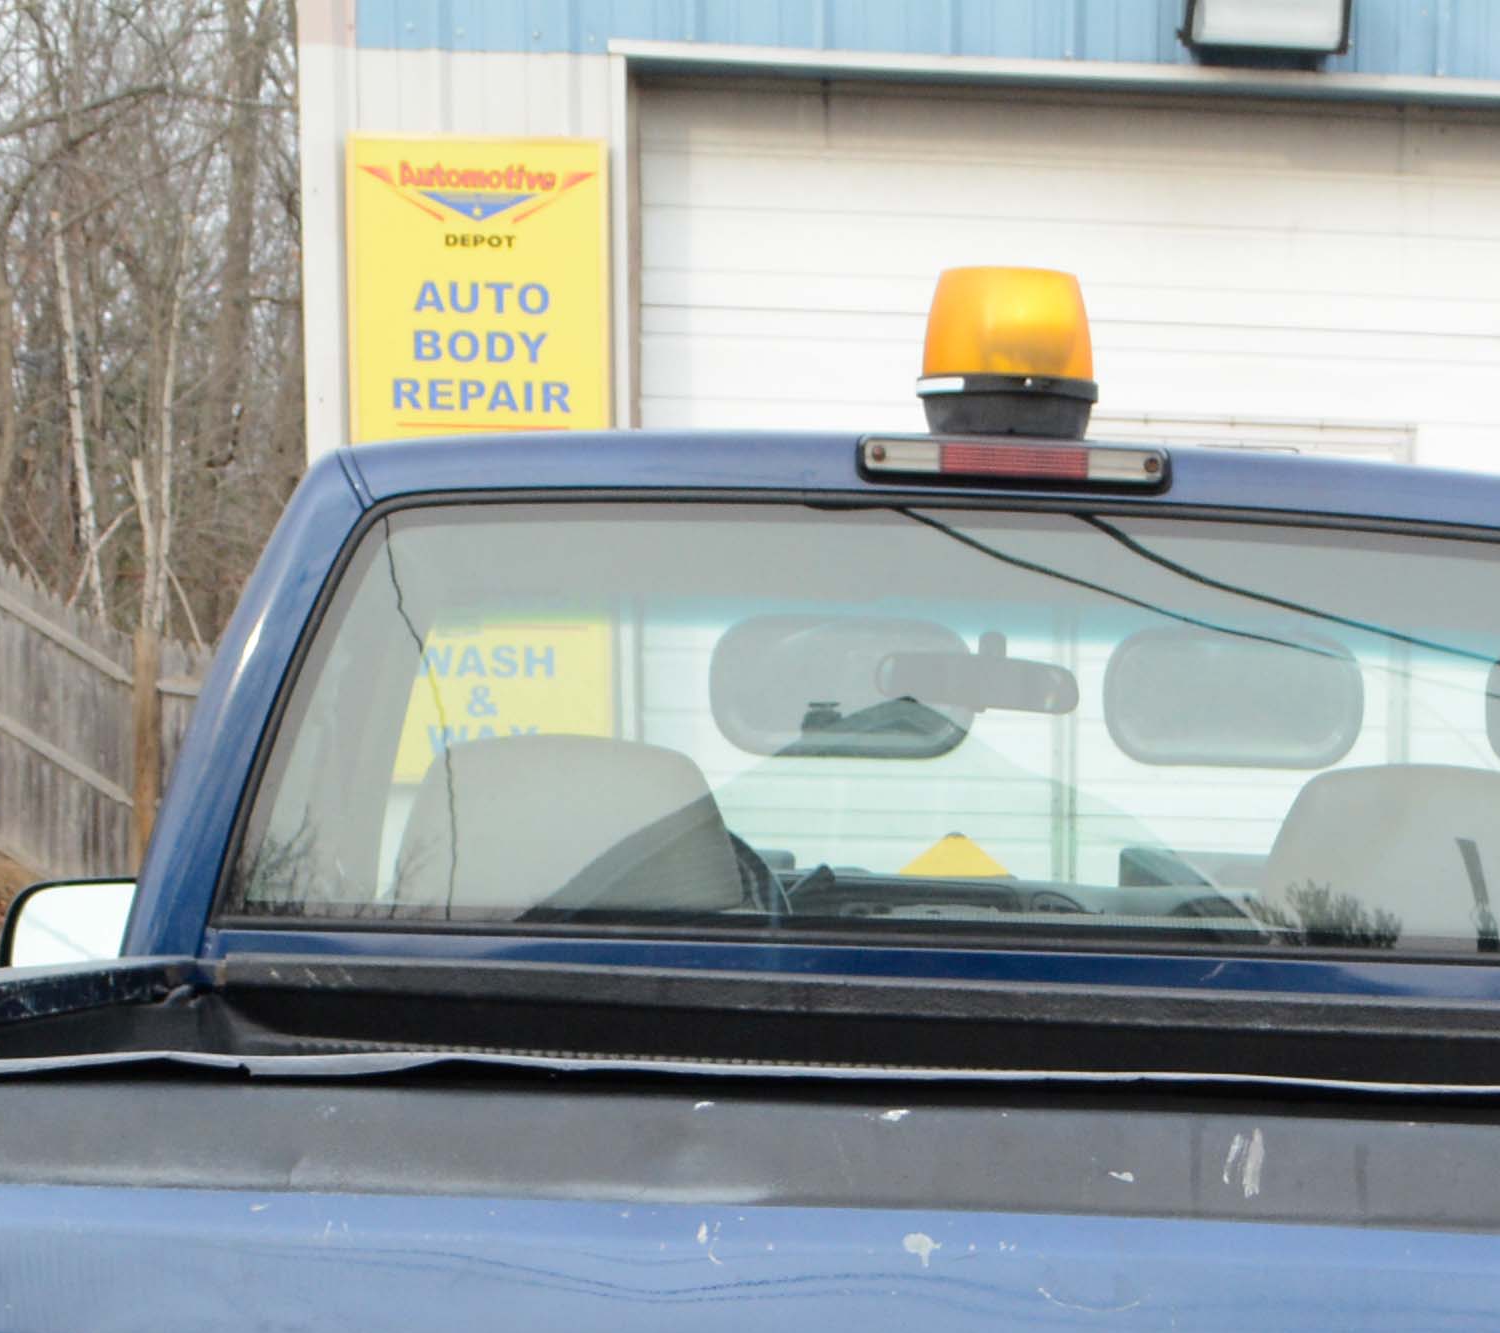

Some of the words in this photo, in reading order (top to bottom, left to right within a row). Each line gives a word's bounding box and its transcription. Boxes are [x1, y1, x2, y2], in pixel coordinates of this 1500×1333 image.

[398, 160, 557, 192] Automotive
[444, 234, 517, 248] DEPOT
[414, 281, 551, 315] AUTO
[413, 330, 549, 364] BODY
[392, 378, 571, 413] REPAIR
[419, 645, 555, 679] WASH
[467, 685, 498, 718] &
